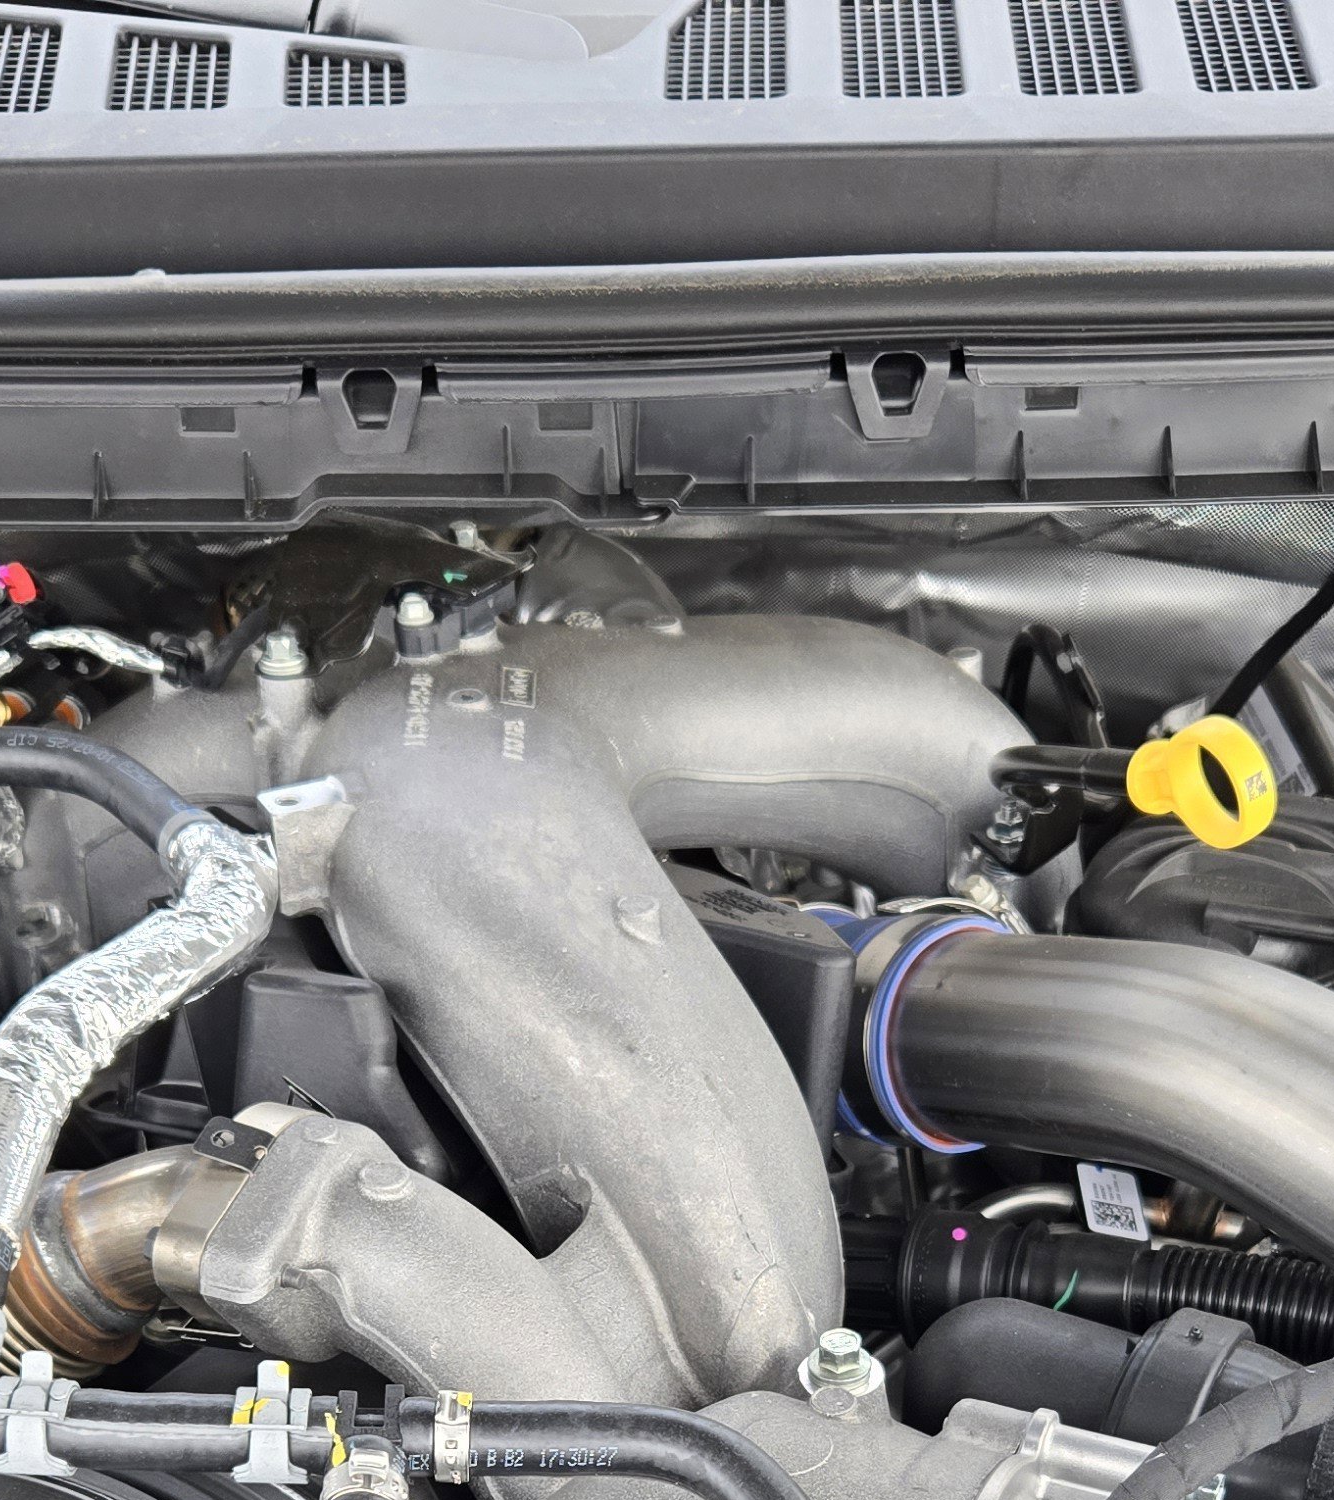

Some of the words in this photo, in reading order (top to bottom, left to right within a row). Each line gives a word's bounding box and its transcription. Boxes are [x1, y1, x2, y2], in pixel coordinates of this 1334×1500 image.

[6, 733, 39, 747] CIP
[487, 1448, 497, 1467] B
[504, 1448, 525, 1467] B2
[539, 1446, 618, 1468] 17:30:27
